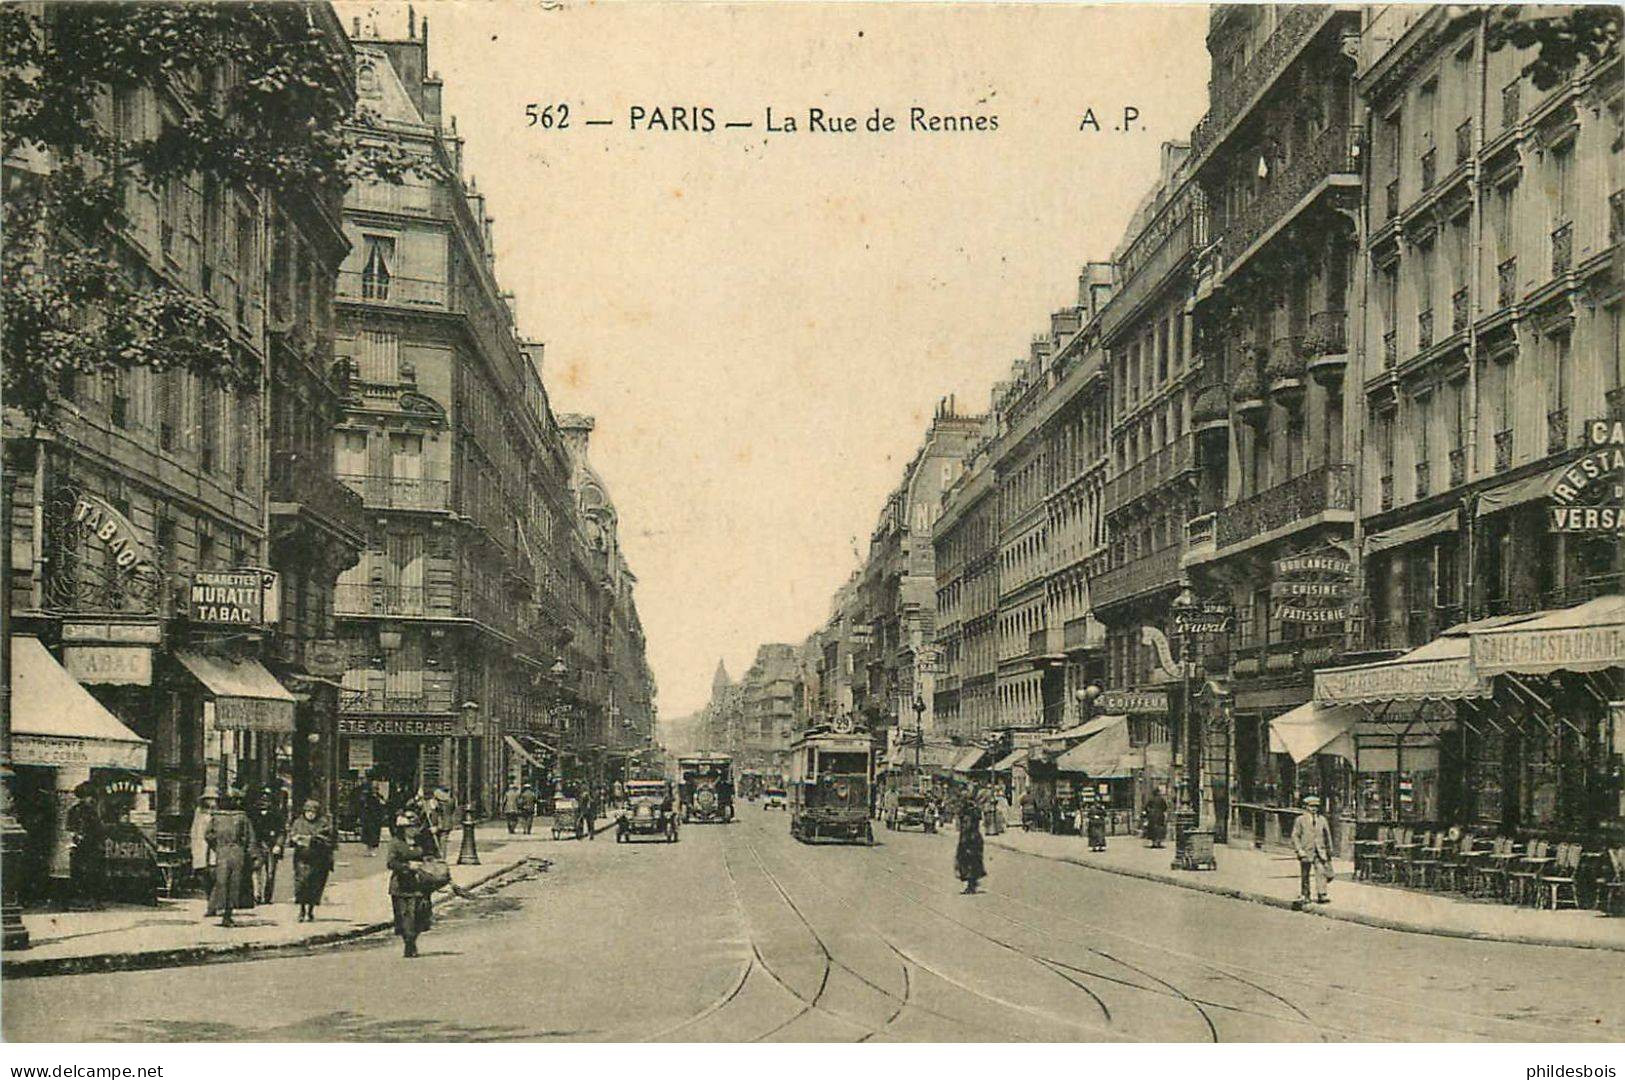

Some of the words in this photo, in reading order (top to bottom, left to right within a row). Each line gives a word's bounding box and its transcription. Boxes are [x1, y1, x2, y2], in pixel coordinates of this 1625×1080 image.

[1592, 421, 1625, 445] CA
[1554, 449, 1625, 502] RESTA
[75, 501, 136, 566] TABAC
[1280, 559, 1352, 574] BOULANGERIE
[195, 573, 257, 586] CIGARETTES
[192, 586, 259, 605] MURATTI
[1292, 585, 1339, 595] CUISINE
[198, 606, 252, 622] TABAC
[1531, 630, 1620, 662] RESTAURANT
[1108, 694, 1168, 708] COIFFEUR
